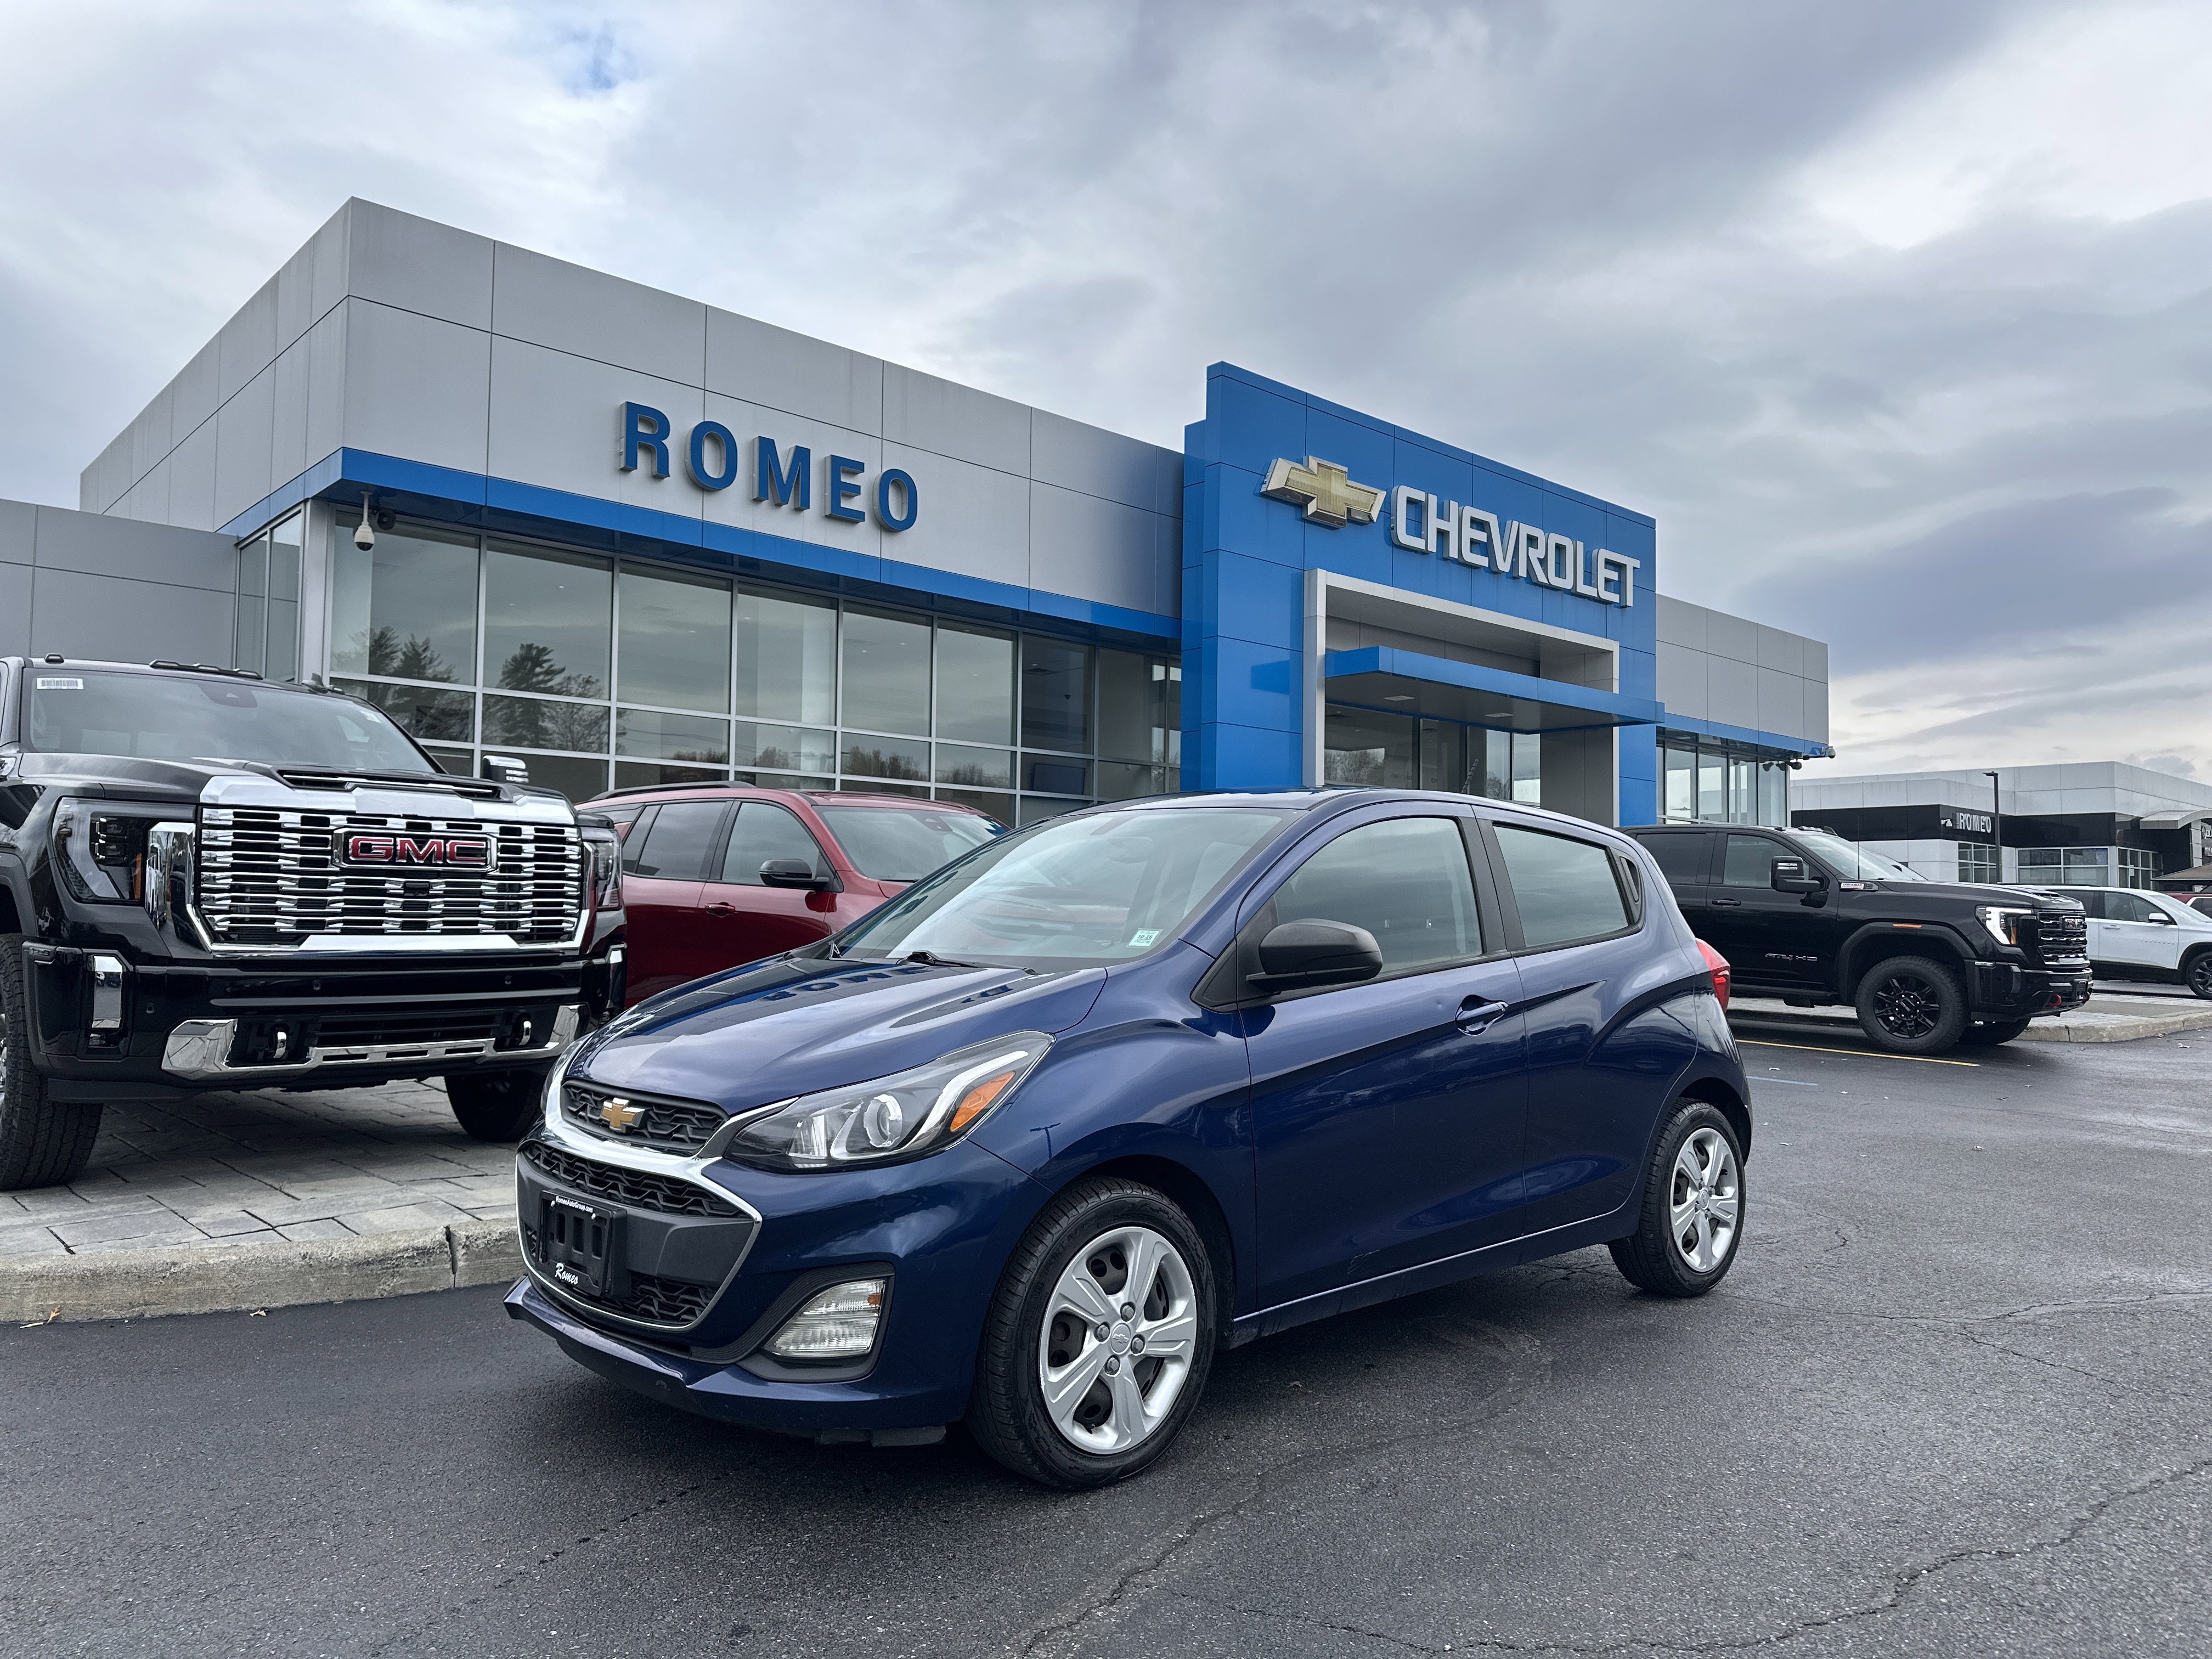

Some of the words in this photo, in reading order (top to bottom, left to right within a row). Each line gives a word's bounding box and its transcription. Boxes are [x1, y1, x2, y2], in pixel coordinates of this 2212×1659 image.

[620, 402, 917, 532] ROMEO
[1391, 485, 1640, 607] CHEVROLET
[1956, 812, 1991, 833] ROMEO
[349, 836, 487, 865] GMC
[555, 1262, 578, 1285] Romeo
